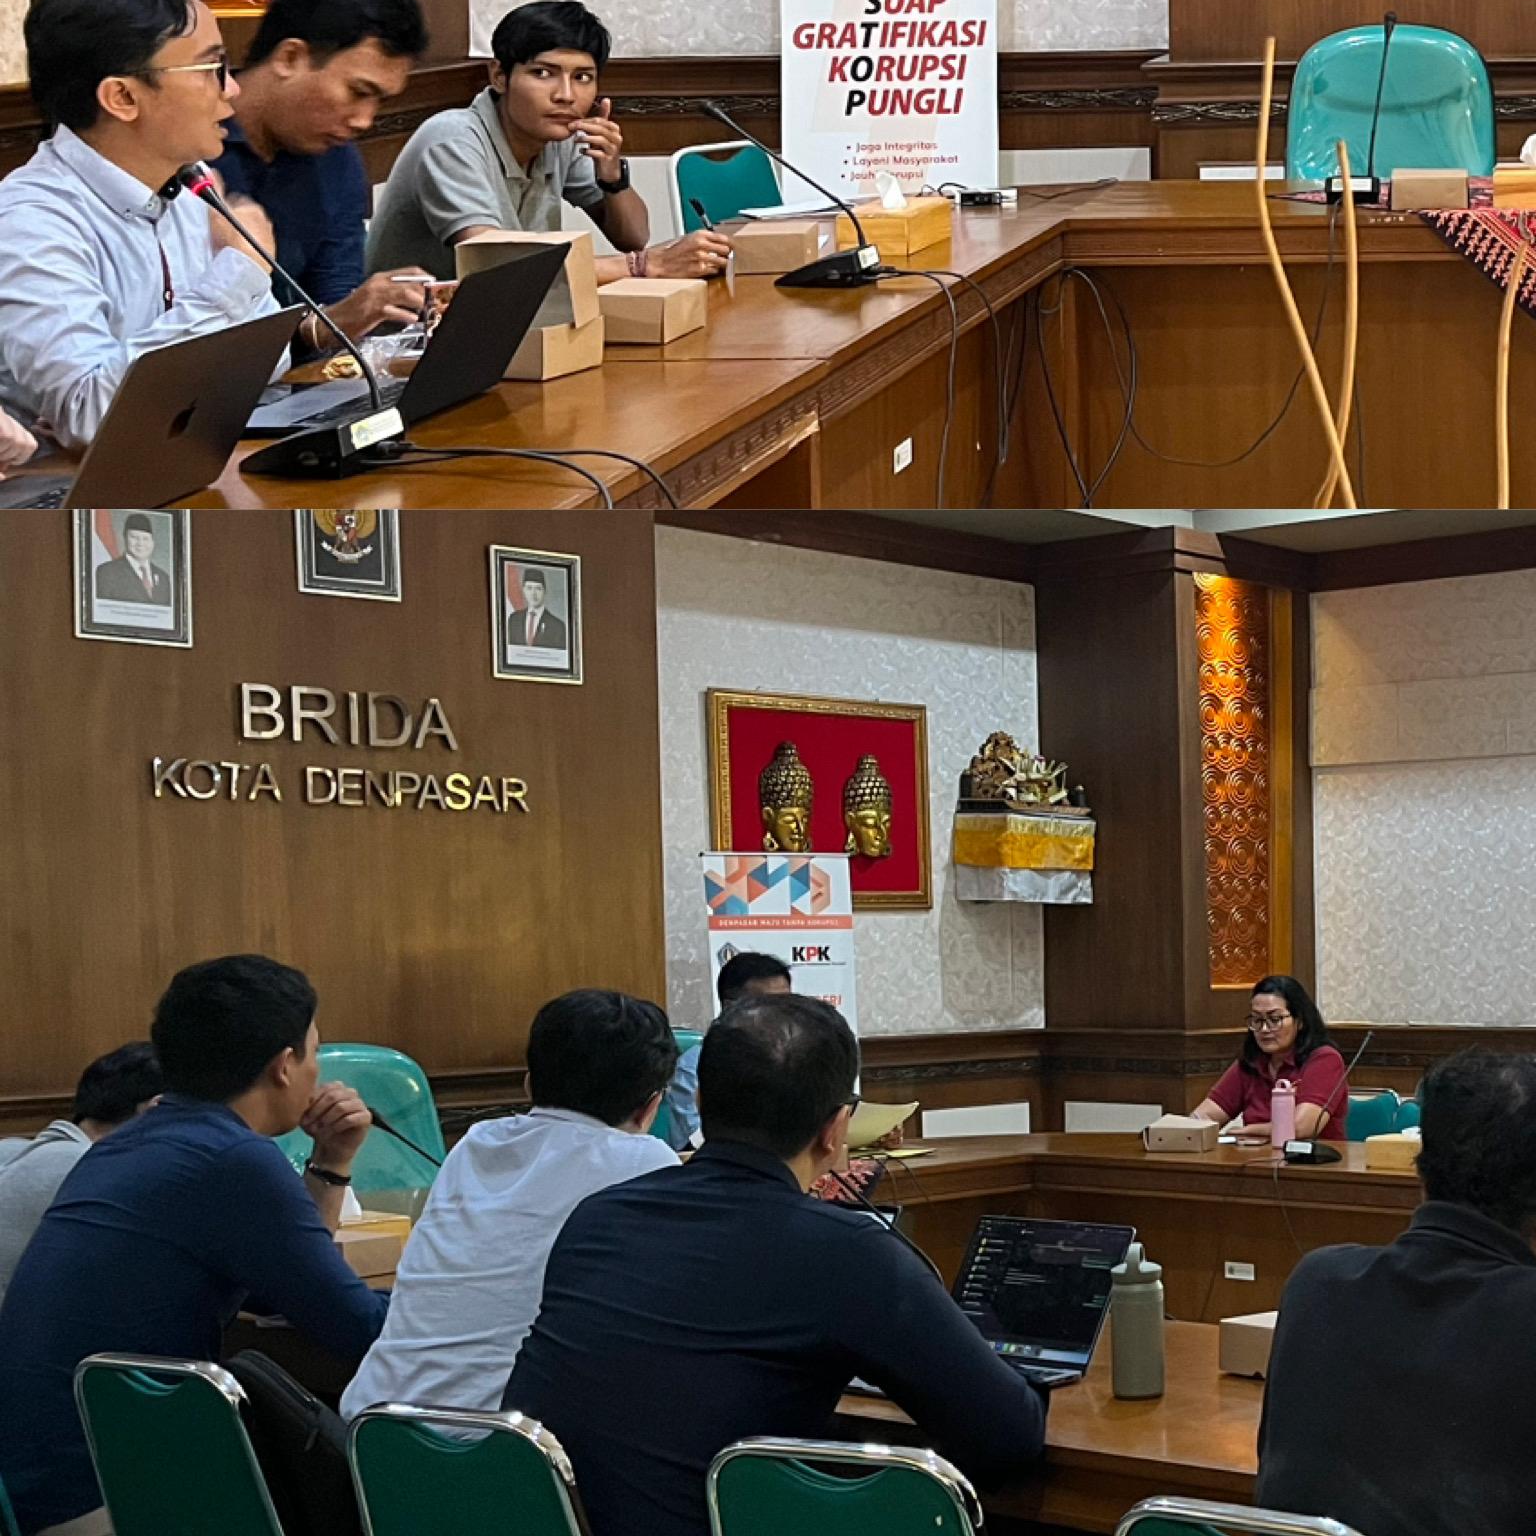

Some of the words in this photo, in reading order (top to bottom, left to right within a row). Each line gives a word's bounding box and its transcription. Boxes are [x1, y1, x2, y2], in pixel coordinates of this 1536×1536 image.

[792, 20, 987, 50] GRATIFIKASI
[828, 54, 967, 83] KORUPSI
[844, 88, 964, 117] PUNGLI
[854, 156, 889, 167] Layani
[894, 155, 958, 166] Masyarakat
[856, 143, 881, 152] Jaga
[885, 142, 938, 152] Integritas
[850, 171, 876, 181] Jauh
[240, 682, 458, 751] BRIDA
[153, 757, 281, 802] KOTA
[306, 767, 529, 812] DENPASAR
[792, 946, 830, 962] KPK
